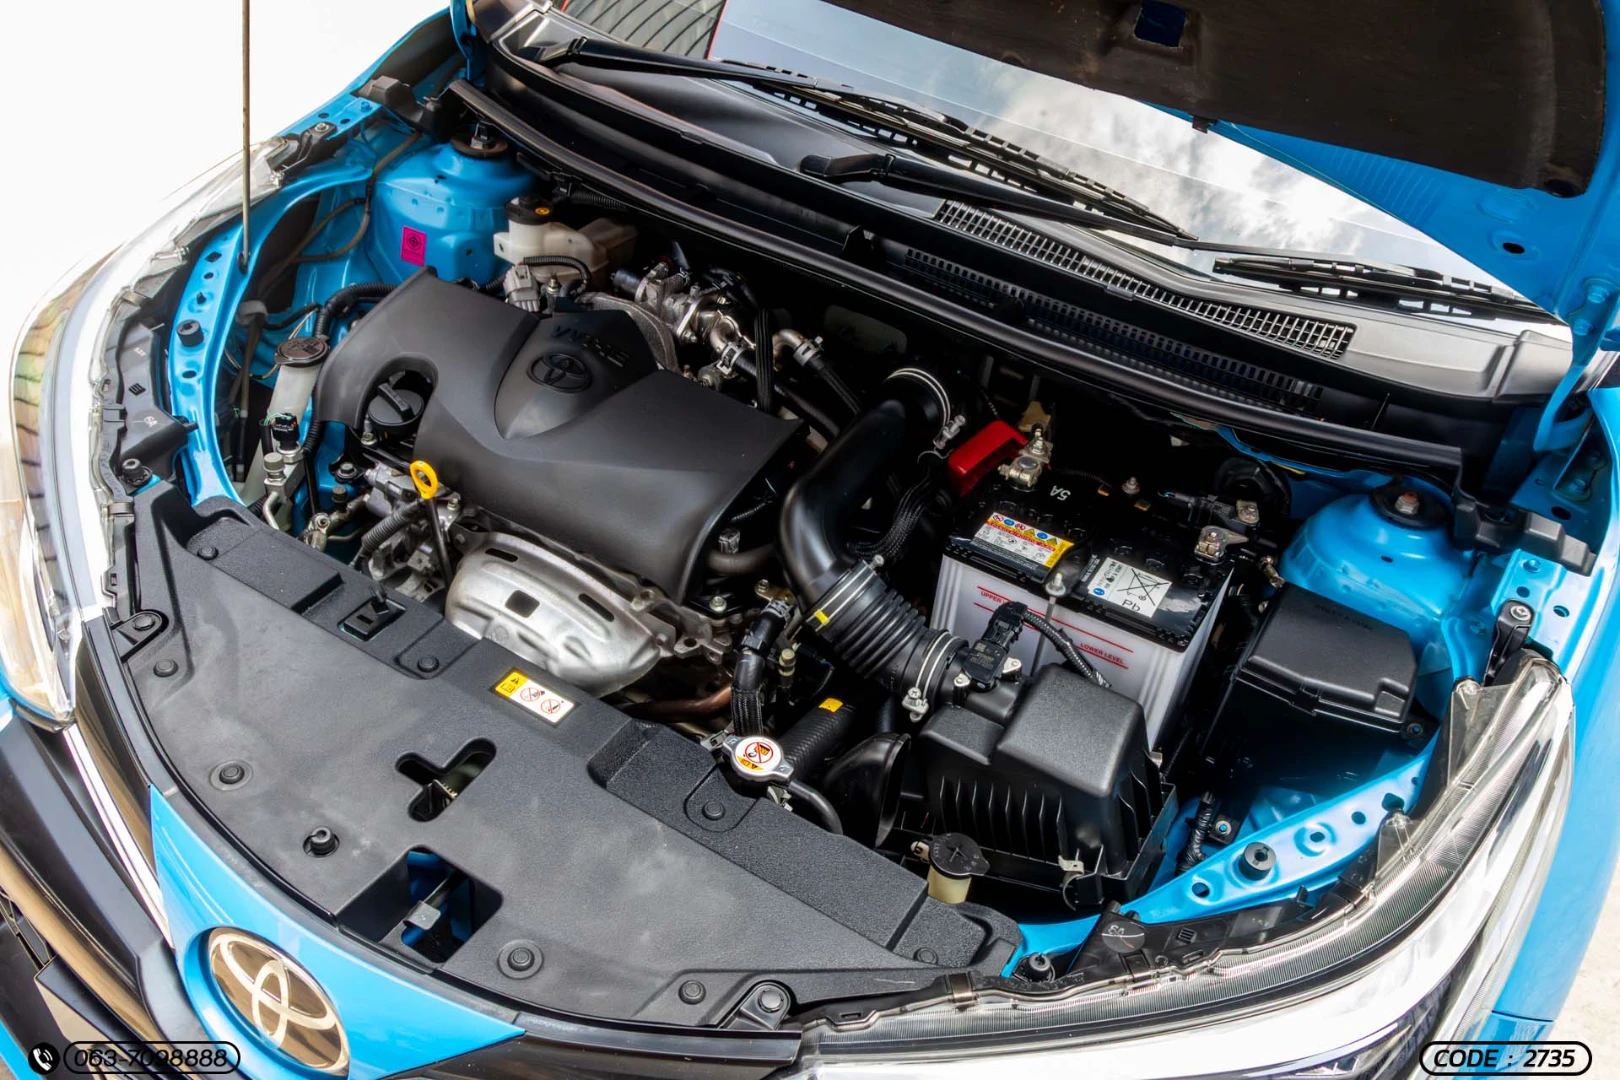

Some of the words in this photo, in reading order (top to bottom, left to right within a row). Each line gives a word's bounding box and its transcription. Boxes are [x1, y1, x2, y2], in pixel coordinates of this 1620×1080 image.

[1050, 485, 1071, 501] 5A
[980, 591, 1002, 603] UPPER
[1122, 599, 1141, 611] Pb
[1080, 643, 1103, 655] LOWER
[1104, 652, 1123, 664] LEVEL
